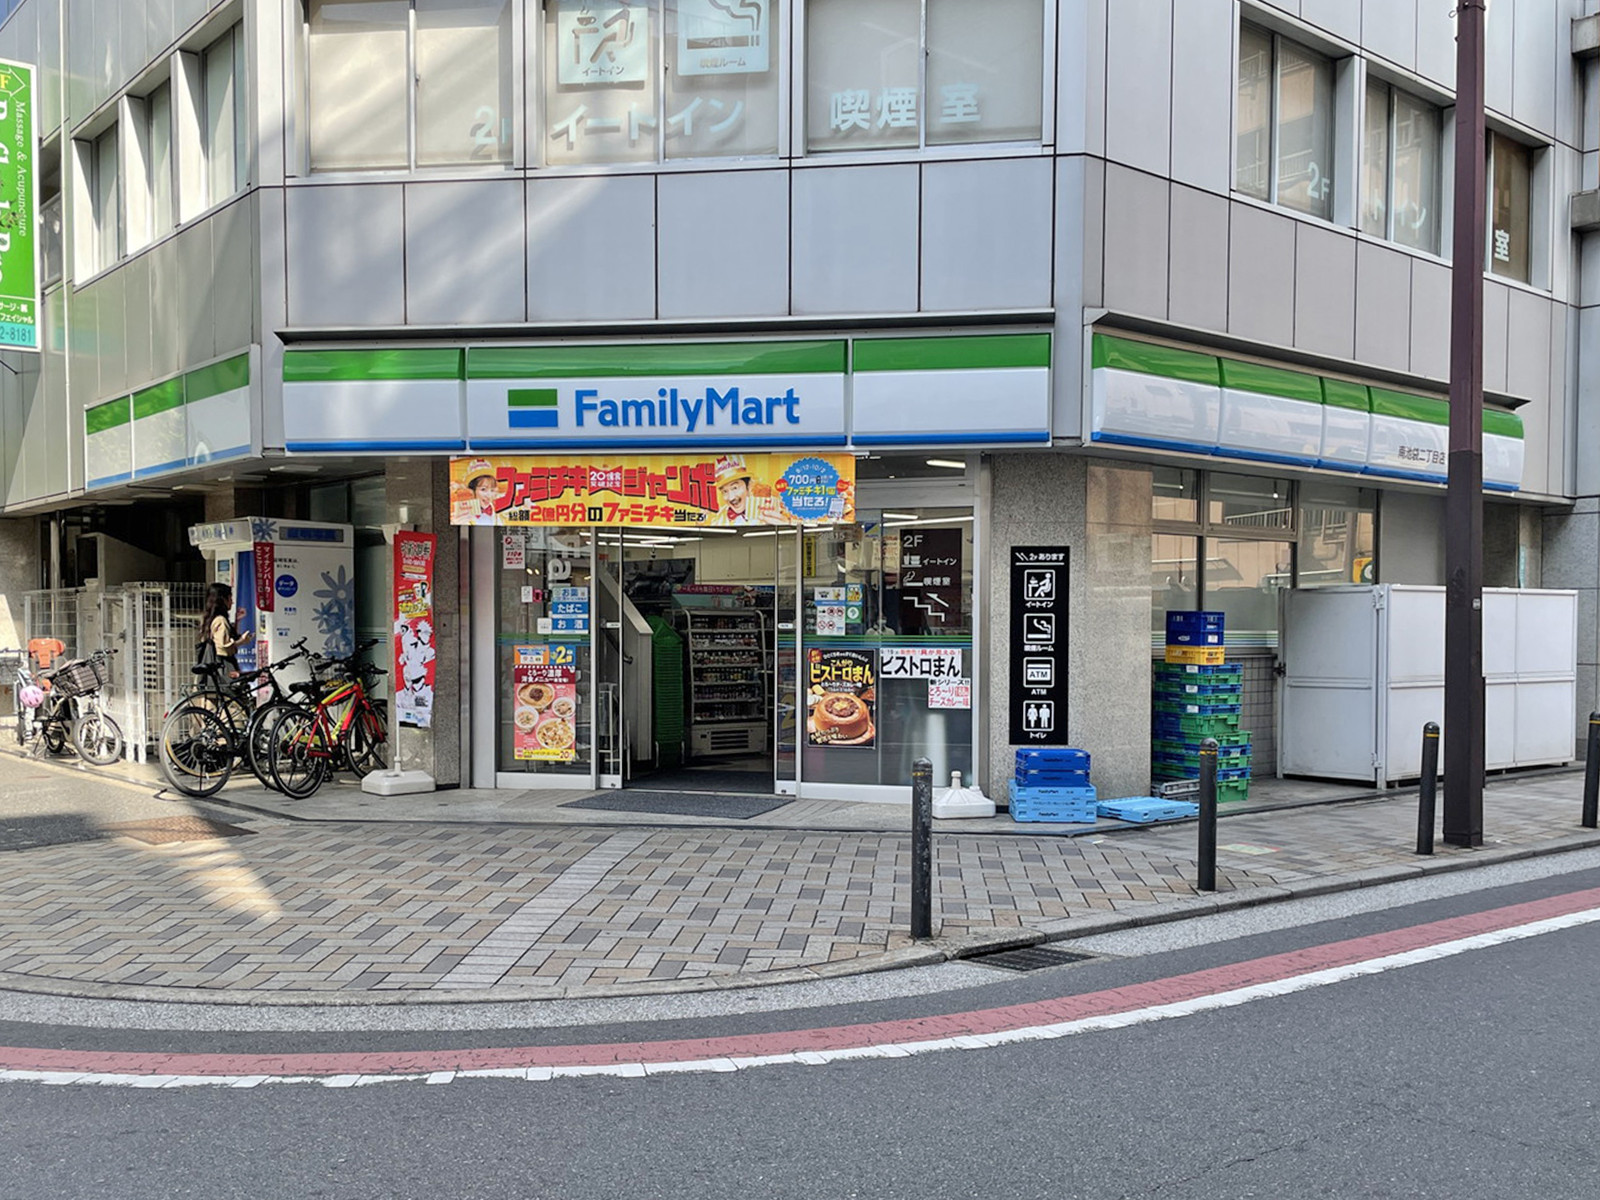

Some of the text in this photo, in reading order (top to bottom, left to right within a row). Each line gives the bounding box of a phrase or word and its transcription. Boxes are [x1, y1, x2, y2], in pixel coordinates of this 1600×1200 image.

[580, 65, 625, 76] イートイン
[829, 81, 983, 132] 喫煙室
[550, 96, 744, 142] イートイン
[14, 100, 28, 238] Massage & Acupuncture
[1307, 161, 1331, 201] 2F
[574, 387, 802, 434] FamilyMart
[495, 462, 719, 514] ファミチキ ジャンボ
[904, 534, 924, 549] 2F
[923, 557, 957, 568] イートイン
[557, 603, 584, 614] たばこ
[810, 662, 875, 686] ビストロまん
[1029, 671, 1048, 679] ATM
[1029, 731, 1047, 739] トイレ
